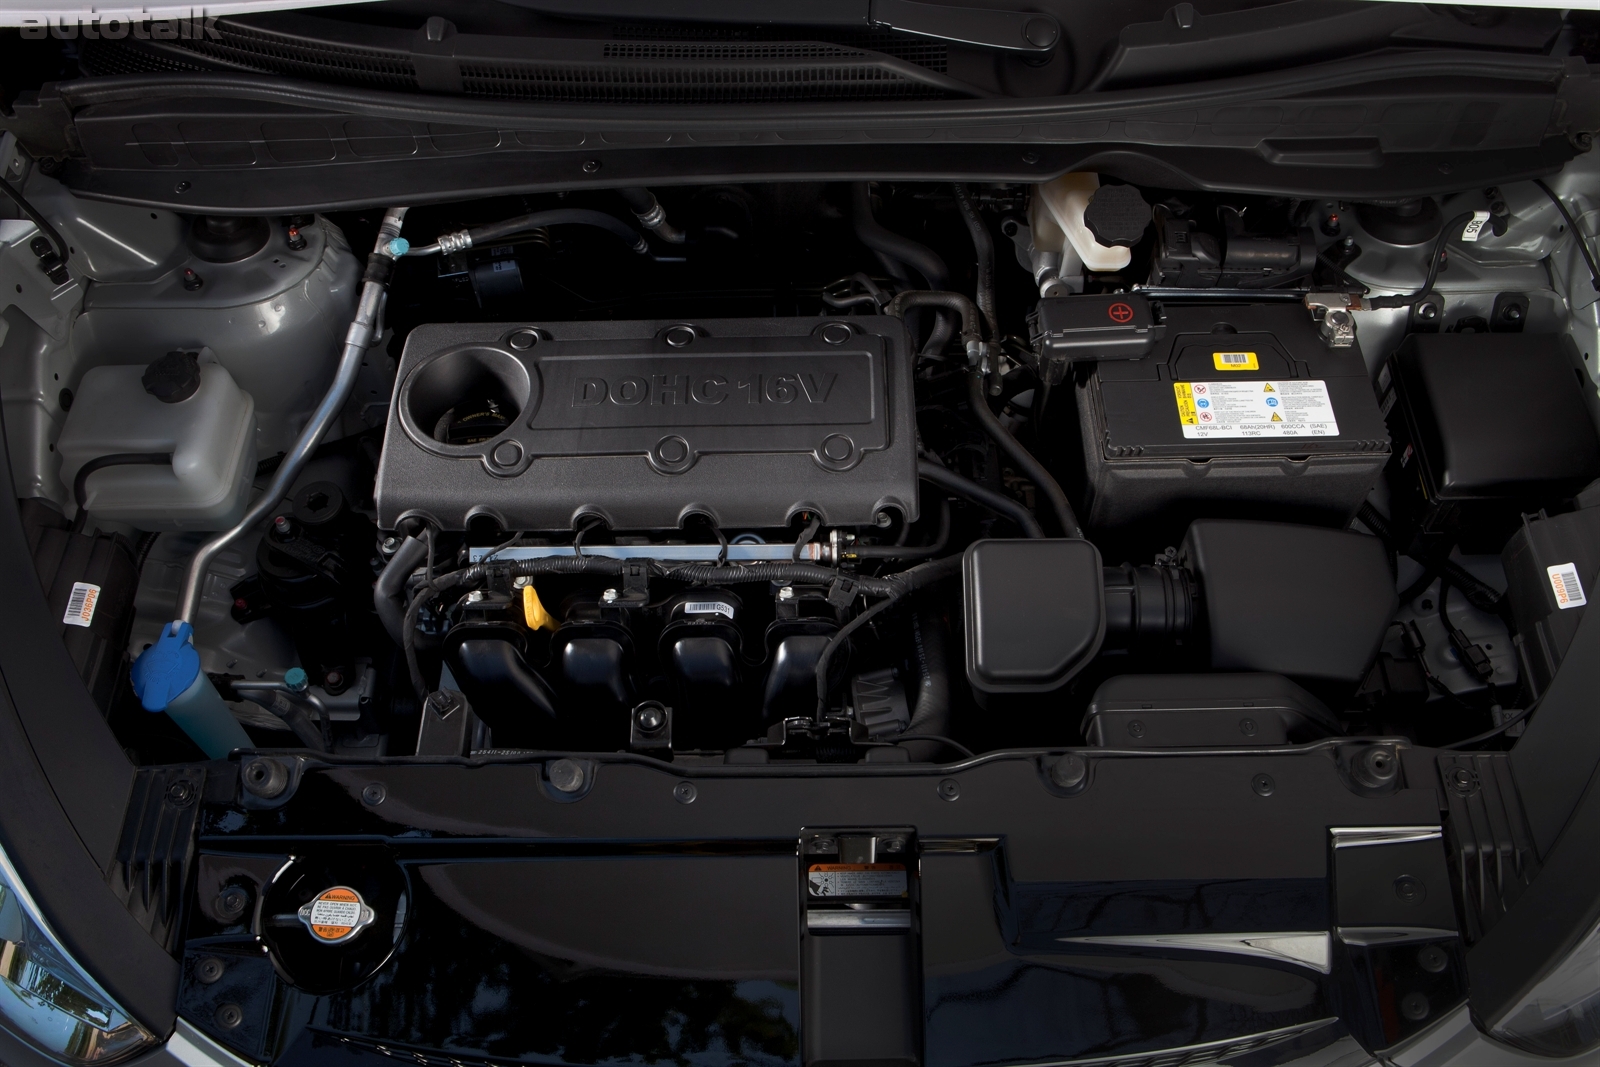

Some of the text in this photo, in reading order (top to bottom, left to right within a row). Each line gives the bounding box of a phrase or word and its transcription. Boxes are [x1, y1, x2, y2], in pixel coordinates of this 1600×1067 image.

[1466, 220, 1483, 234] B05
[572, 373, 838, 408] DOHC 16V
[1551, 573, 1569, 604] U009P6
[81, 588, 97, 622] J036P06
